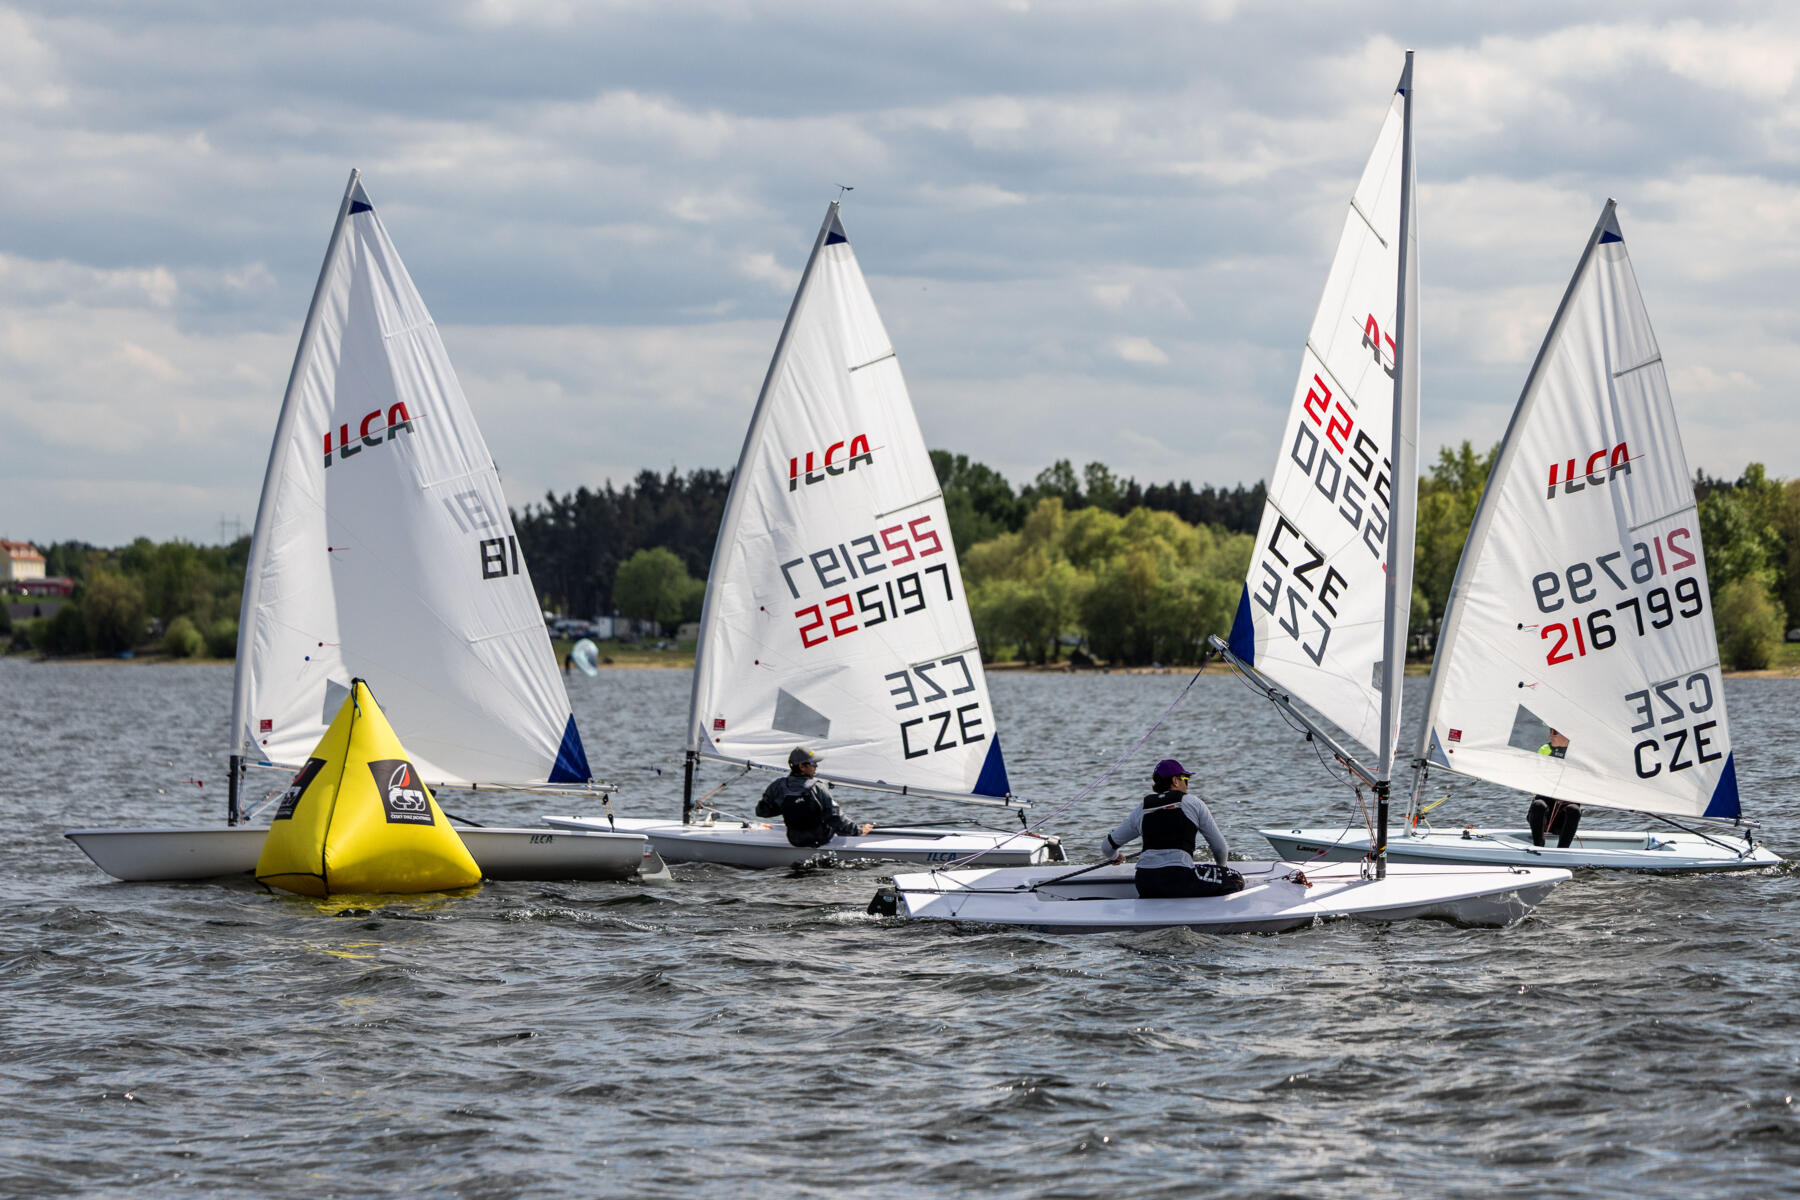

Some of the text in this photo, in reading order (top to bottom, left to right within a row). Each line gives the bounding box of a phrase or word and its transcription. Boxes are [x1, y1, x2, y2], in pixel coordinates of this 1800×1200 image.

[323, 401, 415, 469] ILCA
[789, 433, 873, 492] ILCA
[1303, 373, 1392, 512] 2252
[1547, 441, 1632, 500] ILCA
[480, 535, 520, 580] 81
[1268, 515, 1348, 619] CZE
[795, 562, 953, 649] 225197
[1540, 576, 1703, 666] 216799
[900, 702, 985, 760] CZE
[1634, 720, 1722, 780] CZE
[529, 834, 553, 845] ILCA
[926, 851, 957, 862] ILCA
